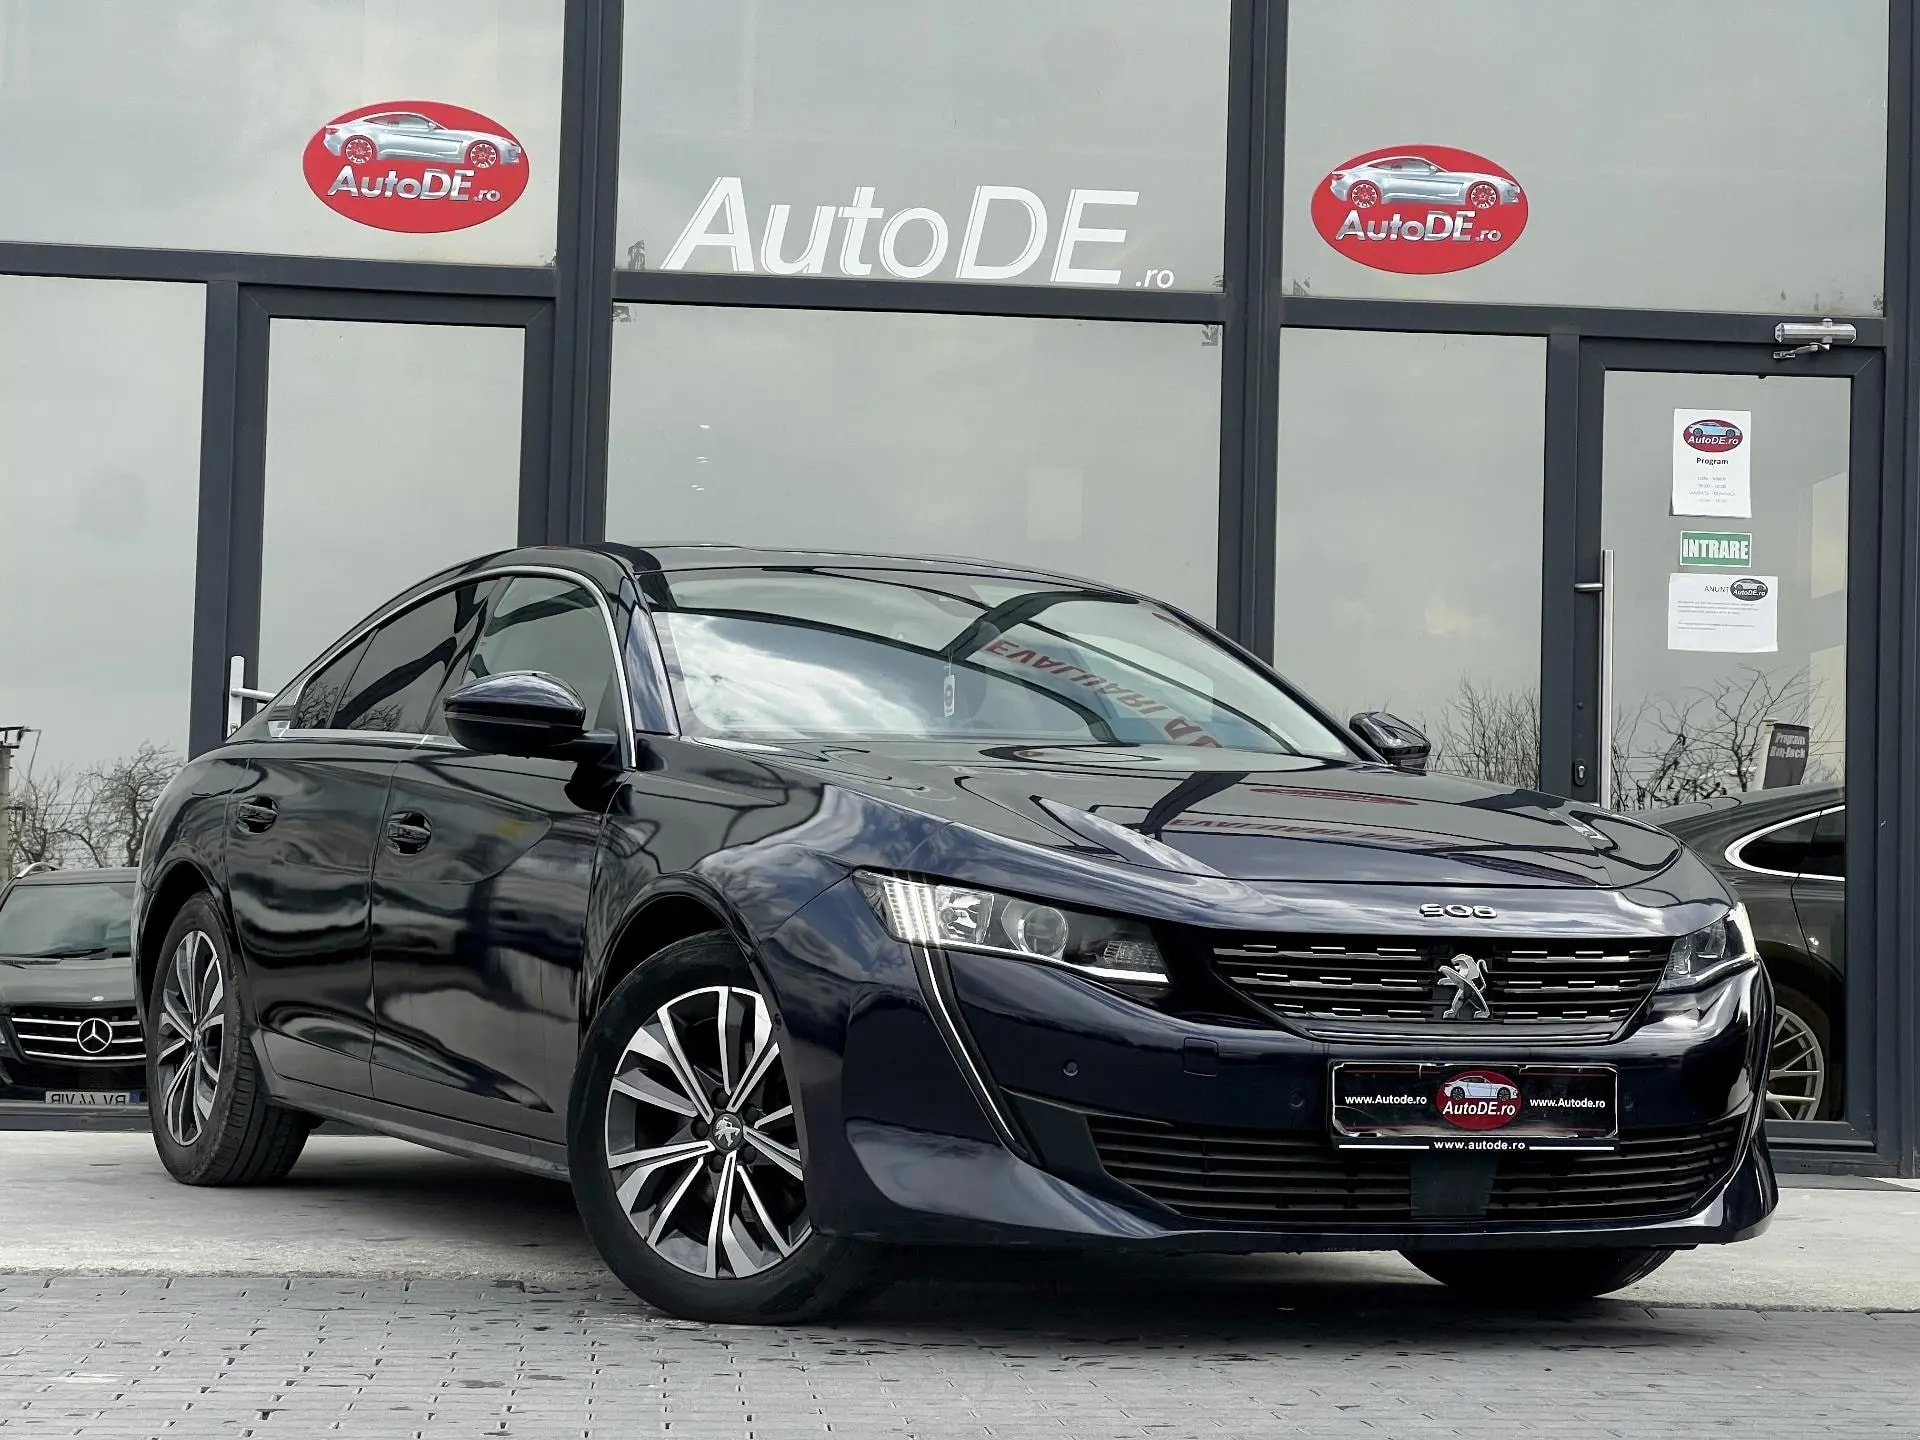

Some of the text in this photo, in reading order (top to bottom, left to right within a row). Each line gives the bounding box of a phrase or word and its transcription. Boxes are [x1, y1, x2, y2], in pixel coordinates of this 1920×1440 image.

[1687, 436, 1739, 445] AutoDE.ro
[1696, 457, 1729, 466] Program
[1682, 538, 1749, 560] INTRARE
[1774, 732, 1806, 745] Program
[1420, 903, 1498, 919] 508
[1344, 1094, 1428, 1105] www.Autode.ro
[1529, 1097, 1606, 1109] www.Autode.ro
[1442, 1101, 1516, 1117] AutoDE.ro
[1433, 1140, 1526, 1151] www.autode.ro
